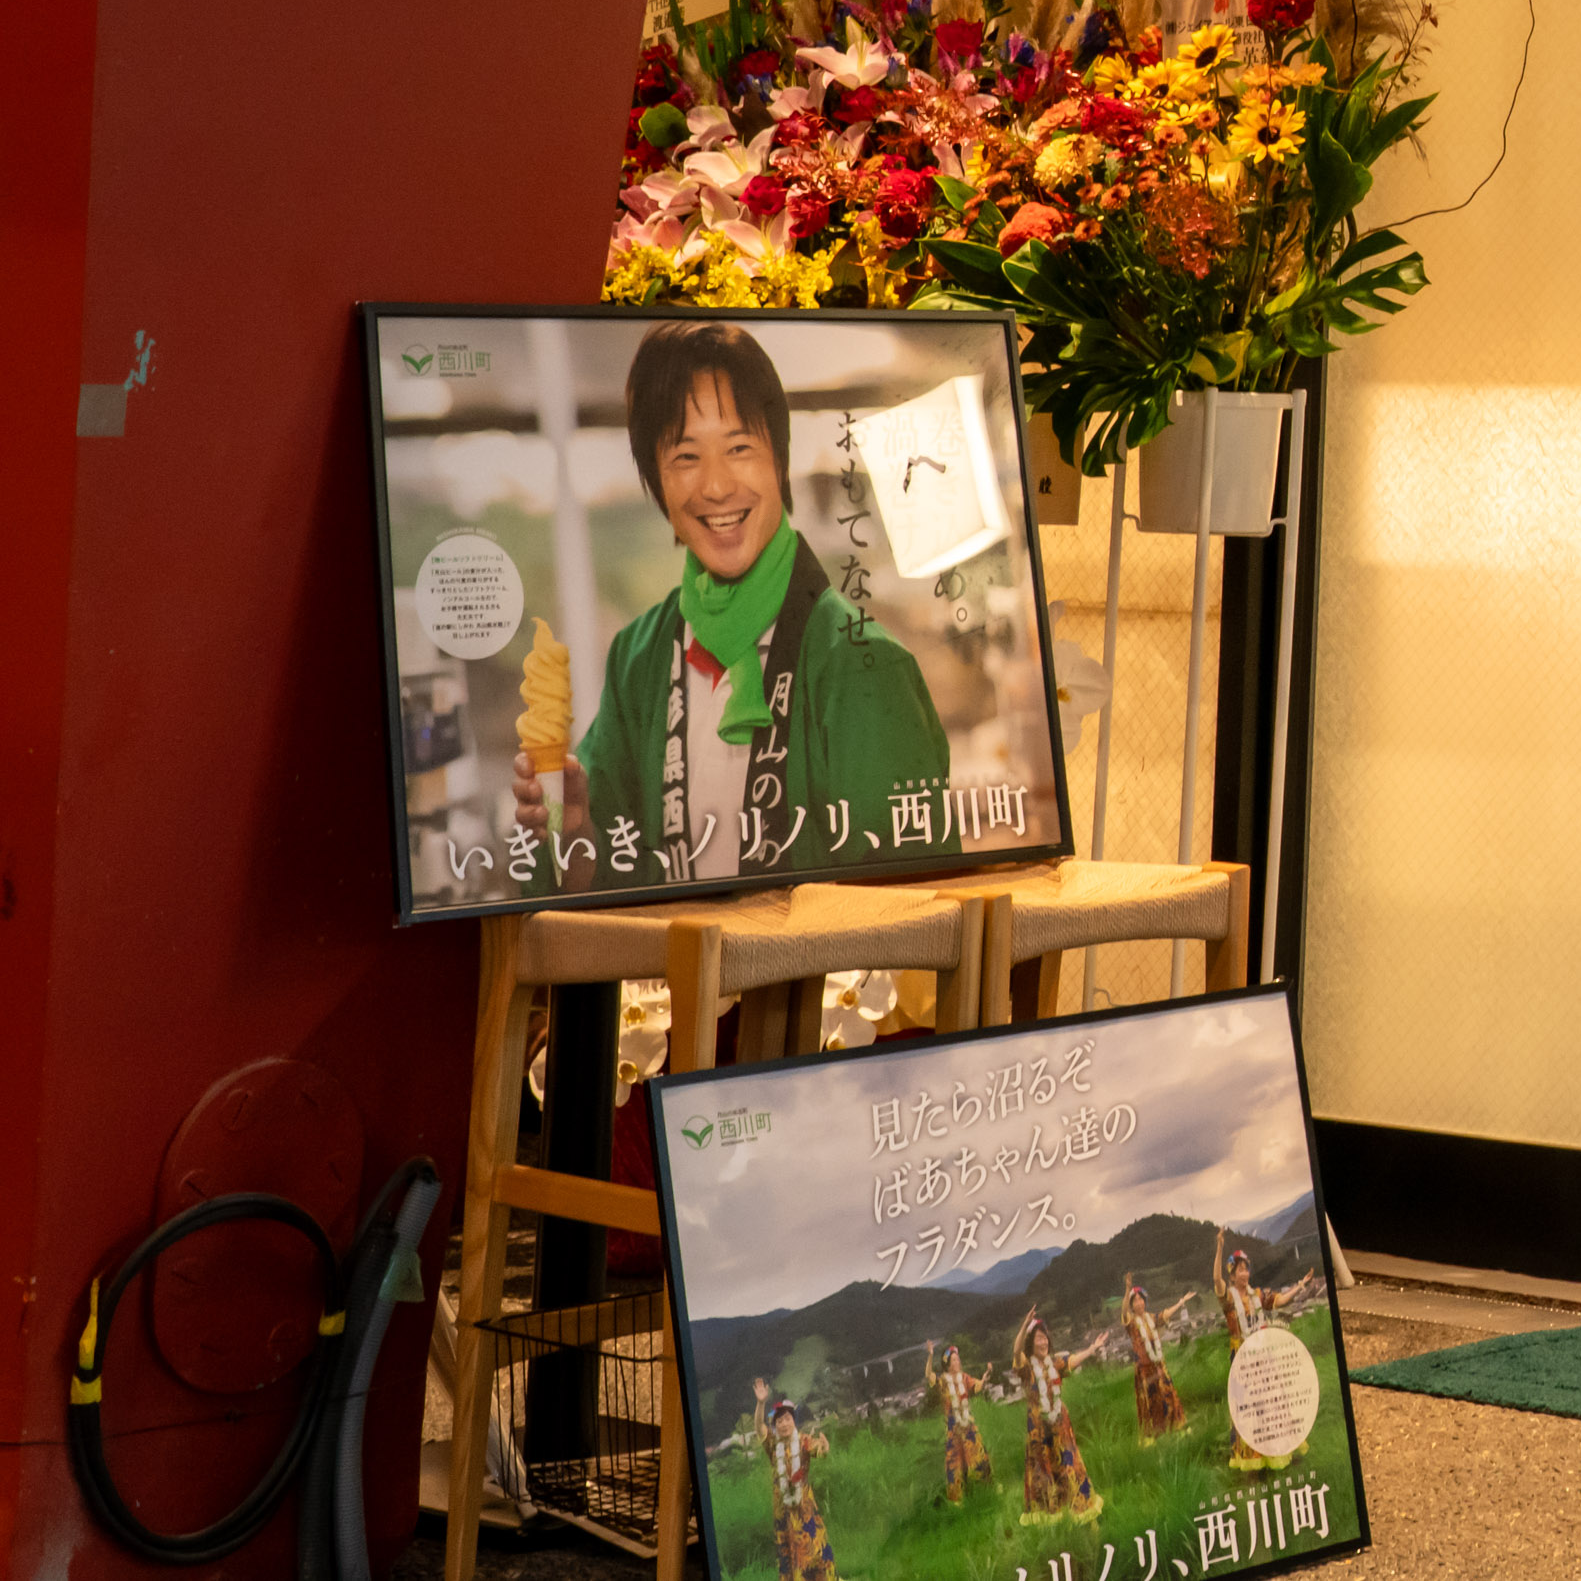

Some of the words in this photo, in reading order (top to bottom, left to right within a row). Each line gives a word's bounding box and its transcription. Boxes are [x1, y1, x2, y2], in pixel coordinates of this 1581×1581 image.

[439, 351, 491, 372] 西川町
[447, 782, 1028, 881] いきいき、ノリノリ、西川町
[718, 1113, 771, 1140] 西川町
[869, 1039, 1096, 1160] 見たら沼るぞ
[873, 1103, 1137, 1225] ばあちゃん達の
[876, 1194, 1076, 1293] フラダンス。
